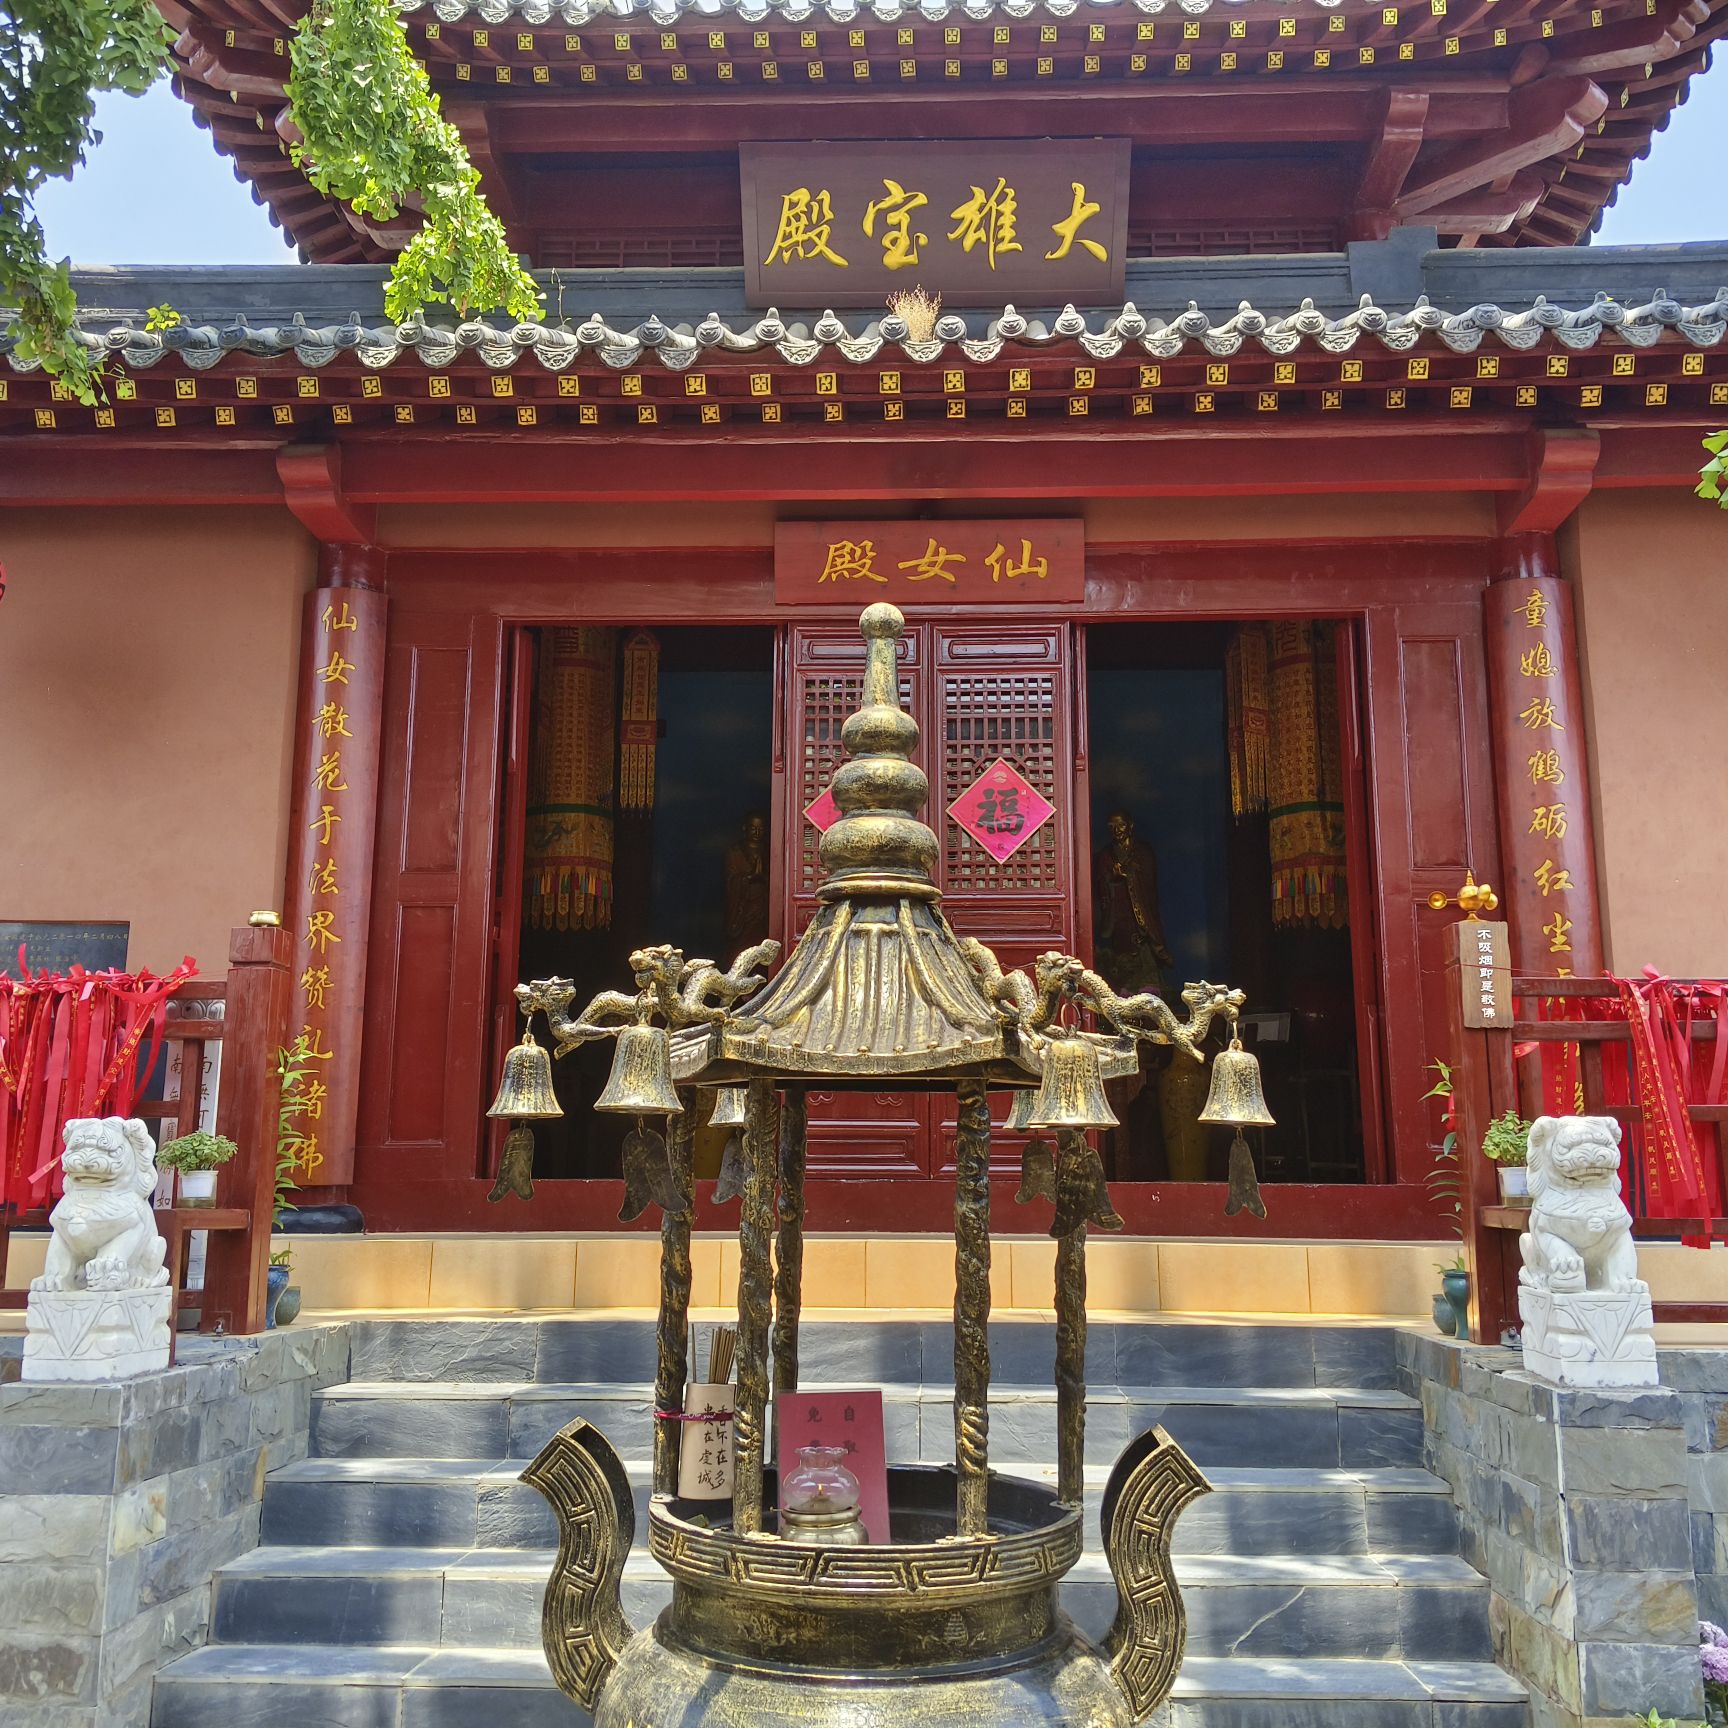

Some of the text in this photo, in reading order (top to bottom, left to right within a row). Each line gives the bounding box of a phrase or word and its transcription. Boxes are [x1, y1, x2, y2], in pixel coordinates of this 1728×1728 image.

[764, 177, 1108, 271] 大雄宝殿
[817, 538, 1048, 583] 仙女殿
[976, 787, 1025, 835] 福
[1477, 929, 1496, 1019] 不吸烟即是敬佛
